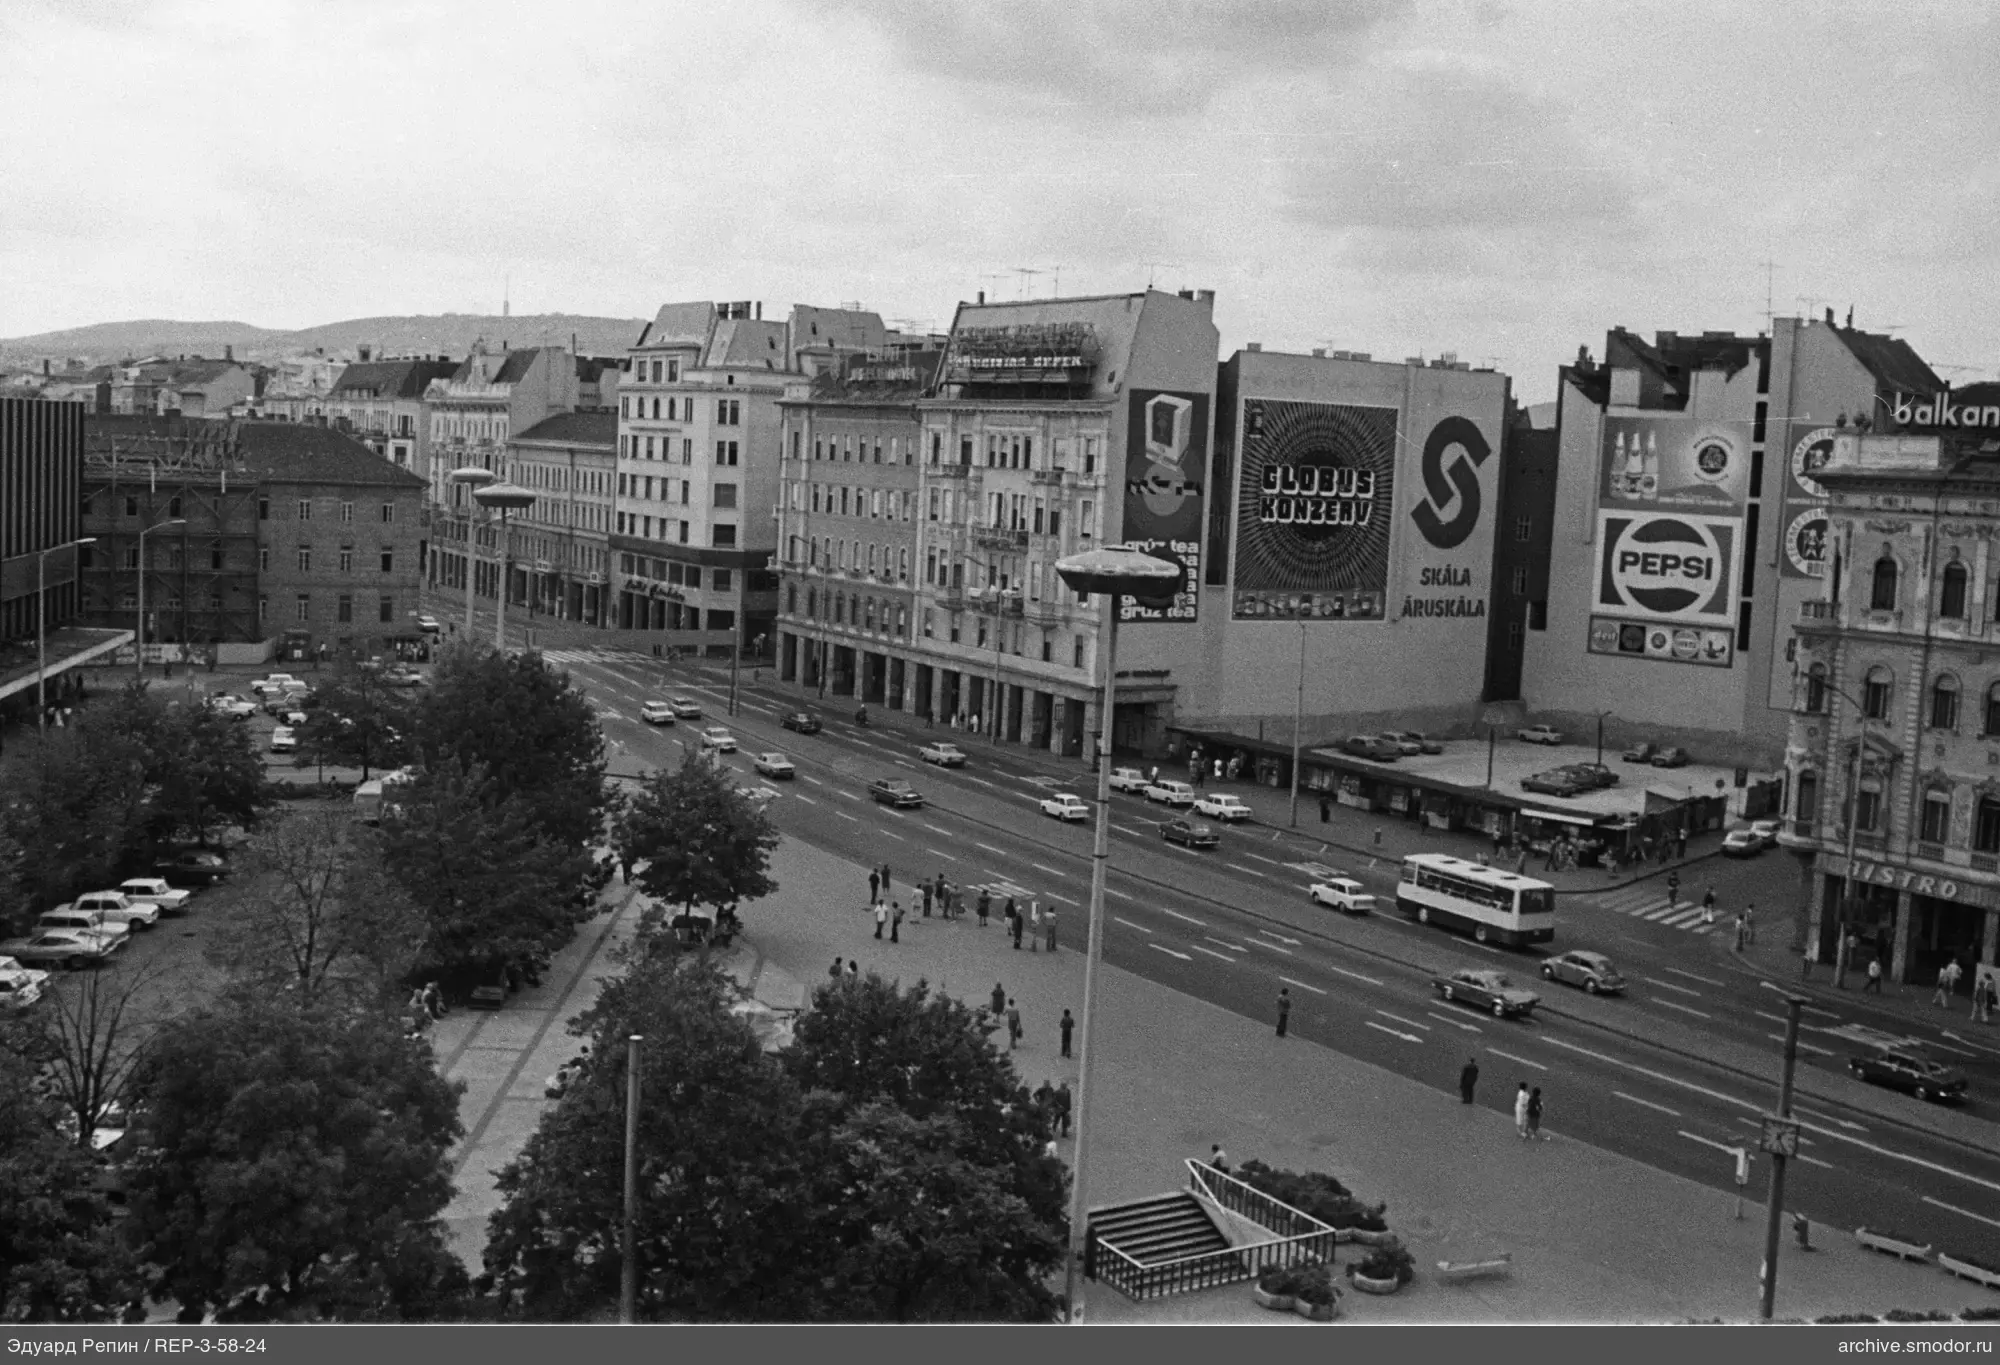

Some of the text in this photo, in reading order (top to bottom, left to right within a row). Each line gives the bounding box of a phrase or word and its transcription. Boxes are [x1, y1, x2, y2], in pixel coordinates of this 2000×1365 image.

[1895, 391, 2000, 427] balkan
[1261, 464, 1375, 498] GLOBUS
[1259, 496, 1372, 526] KONZERV
[1169, 539, 1199, 554] tea
[1420, 564, 1471, 587] SKÁLA
[1619, 550, 1713, 580] PEPSI
[1401, 595, 1485, 618] ÁRUSKÁLA
